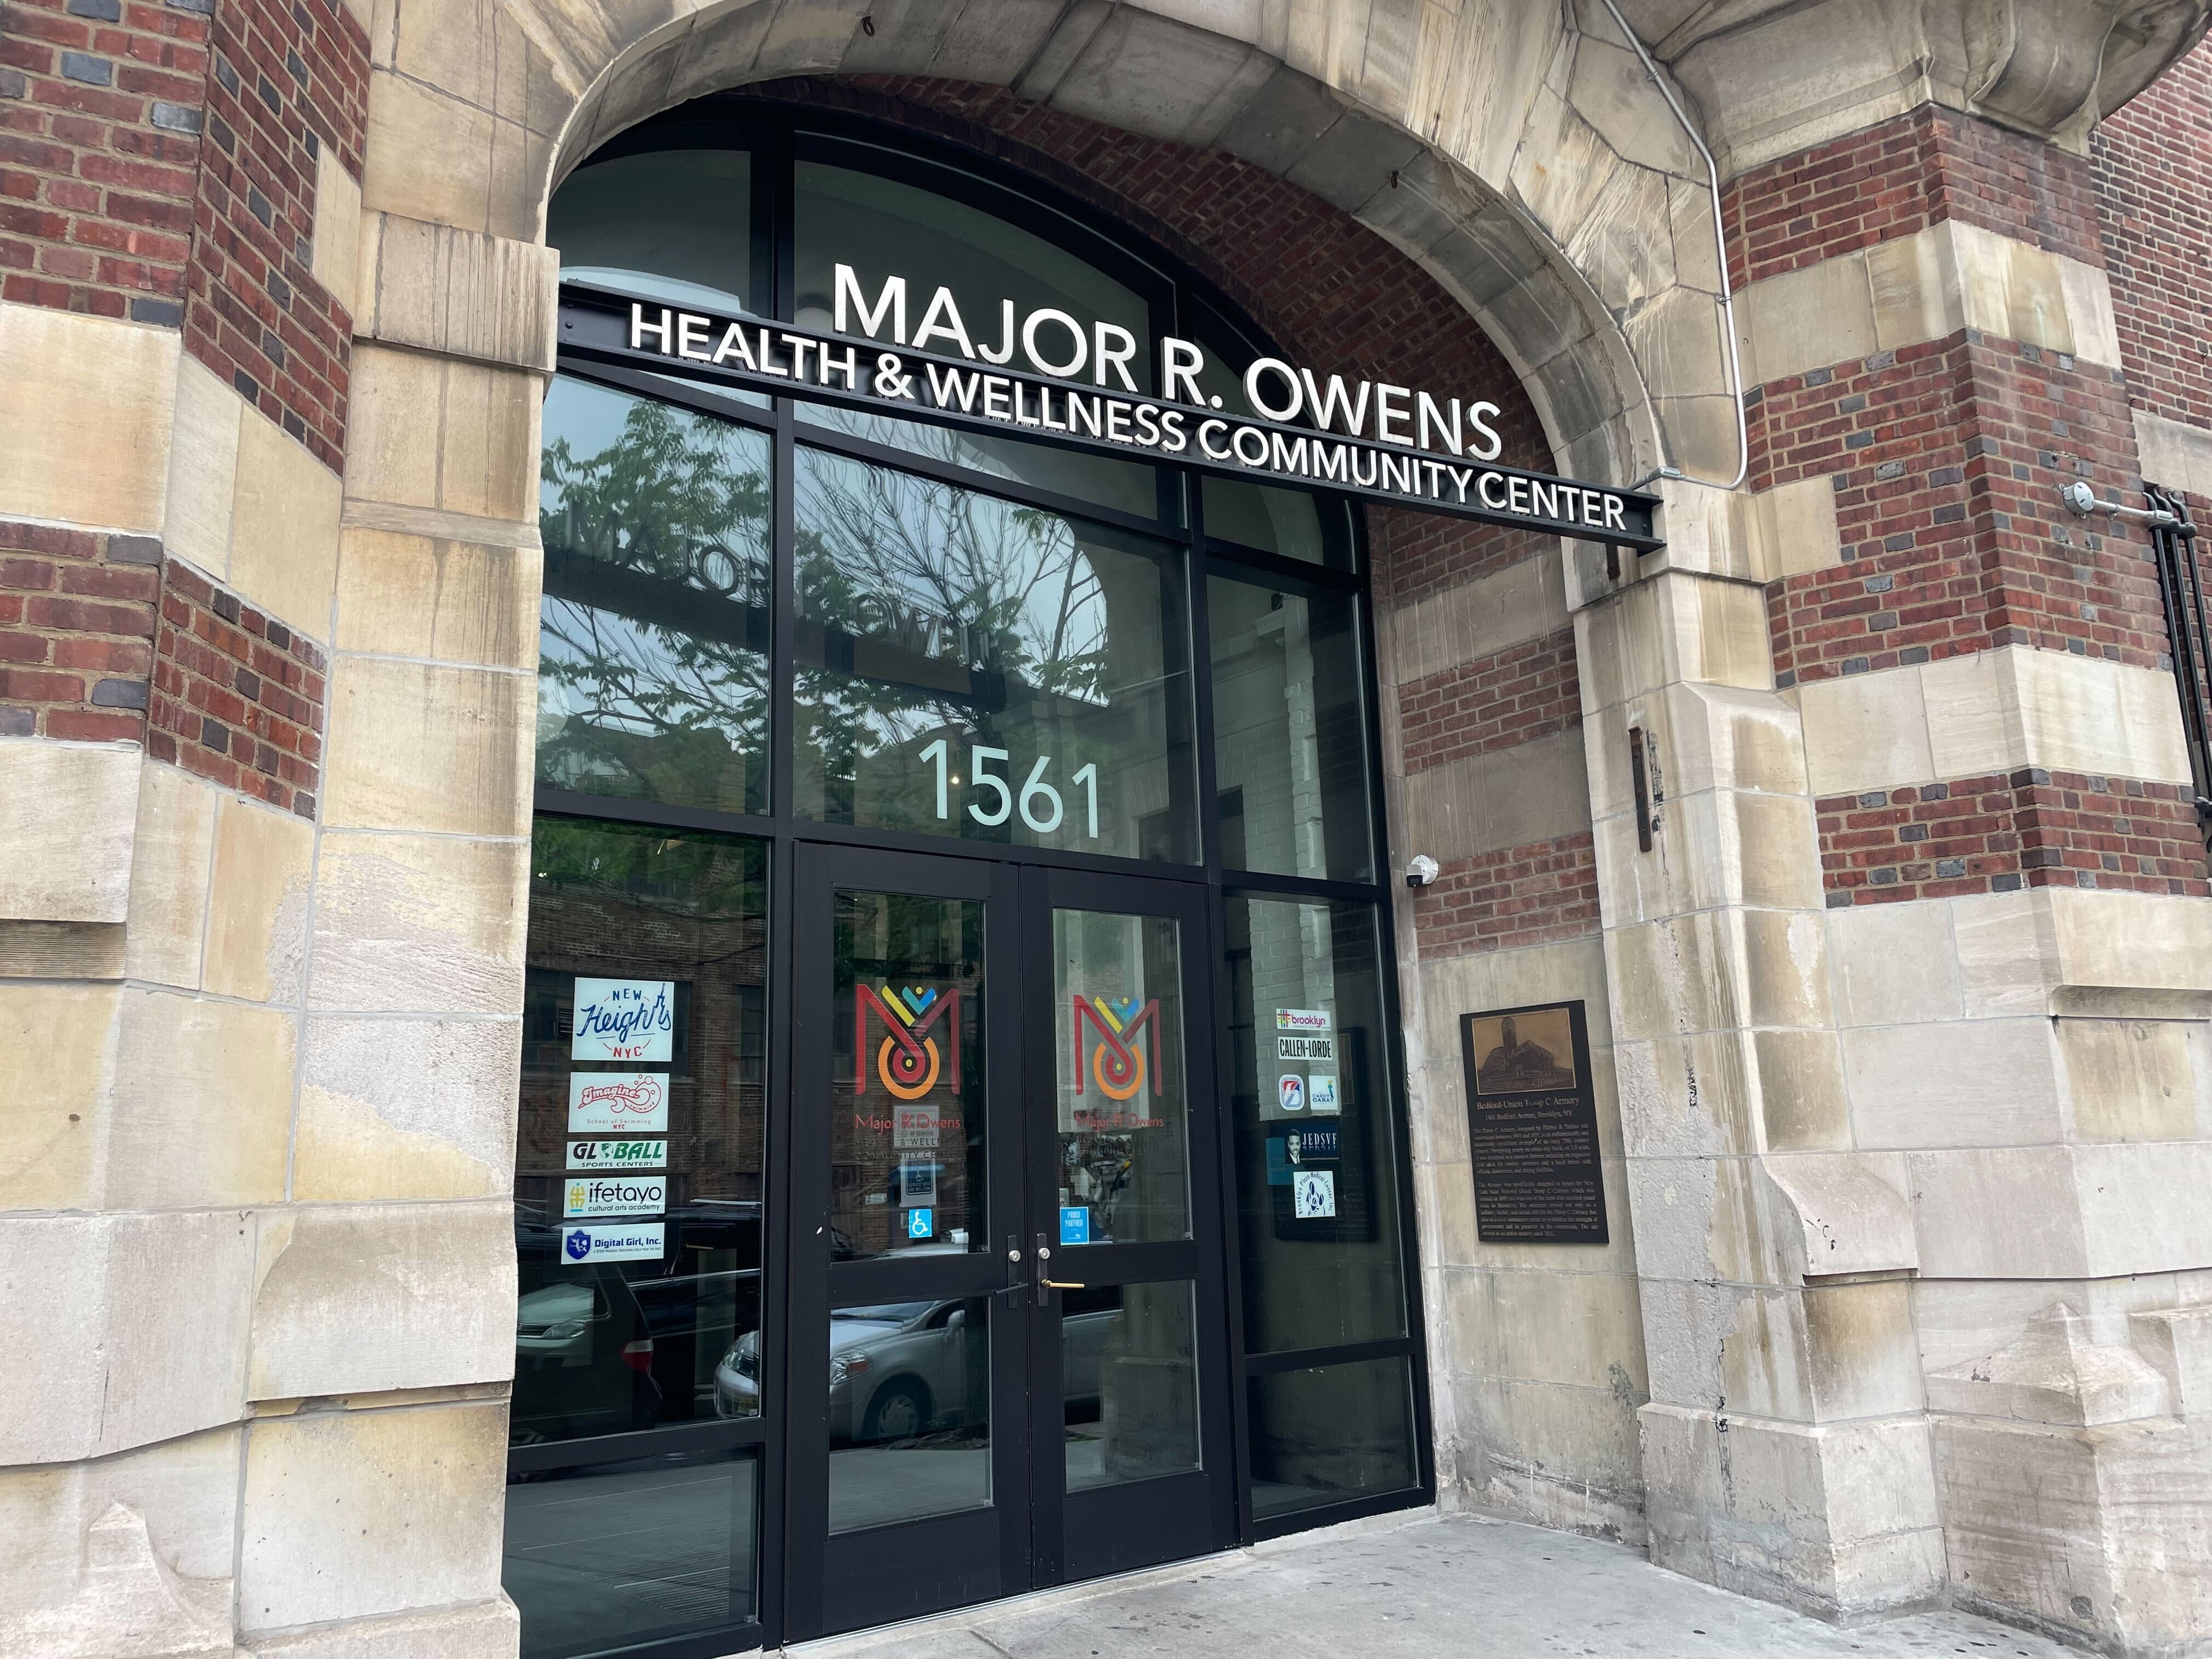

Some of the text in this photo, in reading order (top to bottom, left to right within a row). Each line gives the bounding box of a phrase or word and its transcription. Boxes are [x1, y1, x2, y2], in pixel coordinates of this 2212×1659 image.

[834, 263, 1502, 461] MAJOR R. OWENS
[630, 303, 1628, 532] HEALTH & WELLNESS COMMUNITY CENTER
[918, 739, 1098, 838] 1561
[613, 989, 641, 1001] NEW
[576, 983, 671, 1043] Heights
[613, 1046, 642, 1058] NYC
[1279, 1039, 1331, 1058] CALLEN-LORDE
[582, 1084, 640, 1104] Imagine
[1545, 1097, 1551, 1105] C
[1553, 1097, 1580, 1106] Armory
[855, 1114, 898, 1135] Major
[916, 1114, 961, 1129] Owens
[1127, 1113, 1164, 1127] Owens
[1302, 1132, 1337, 1146] JEDSVF
[1310, 1172, 1325, 1182] Medical
[589, 1182, 662, 1204] ifetayo
[594, 1238, 624, 1249] Digital
[626, 1238, 644, 1246] Girl,
